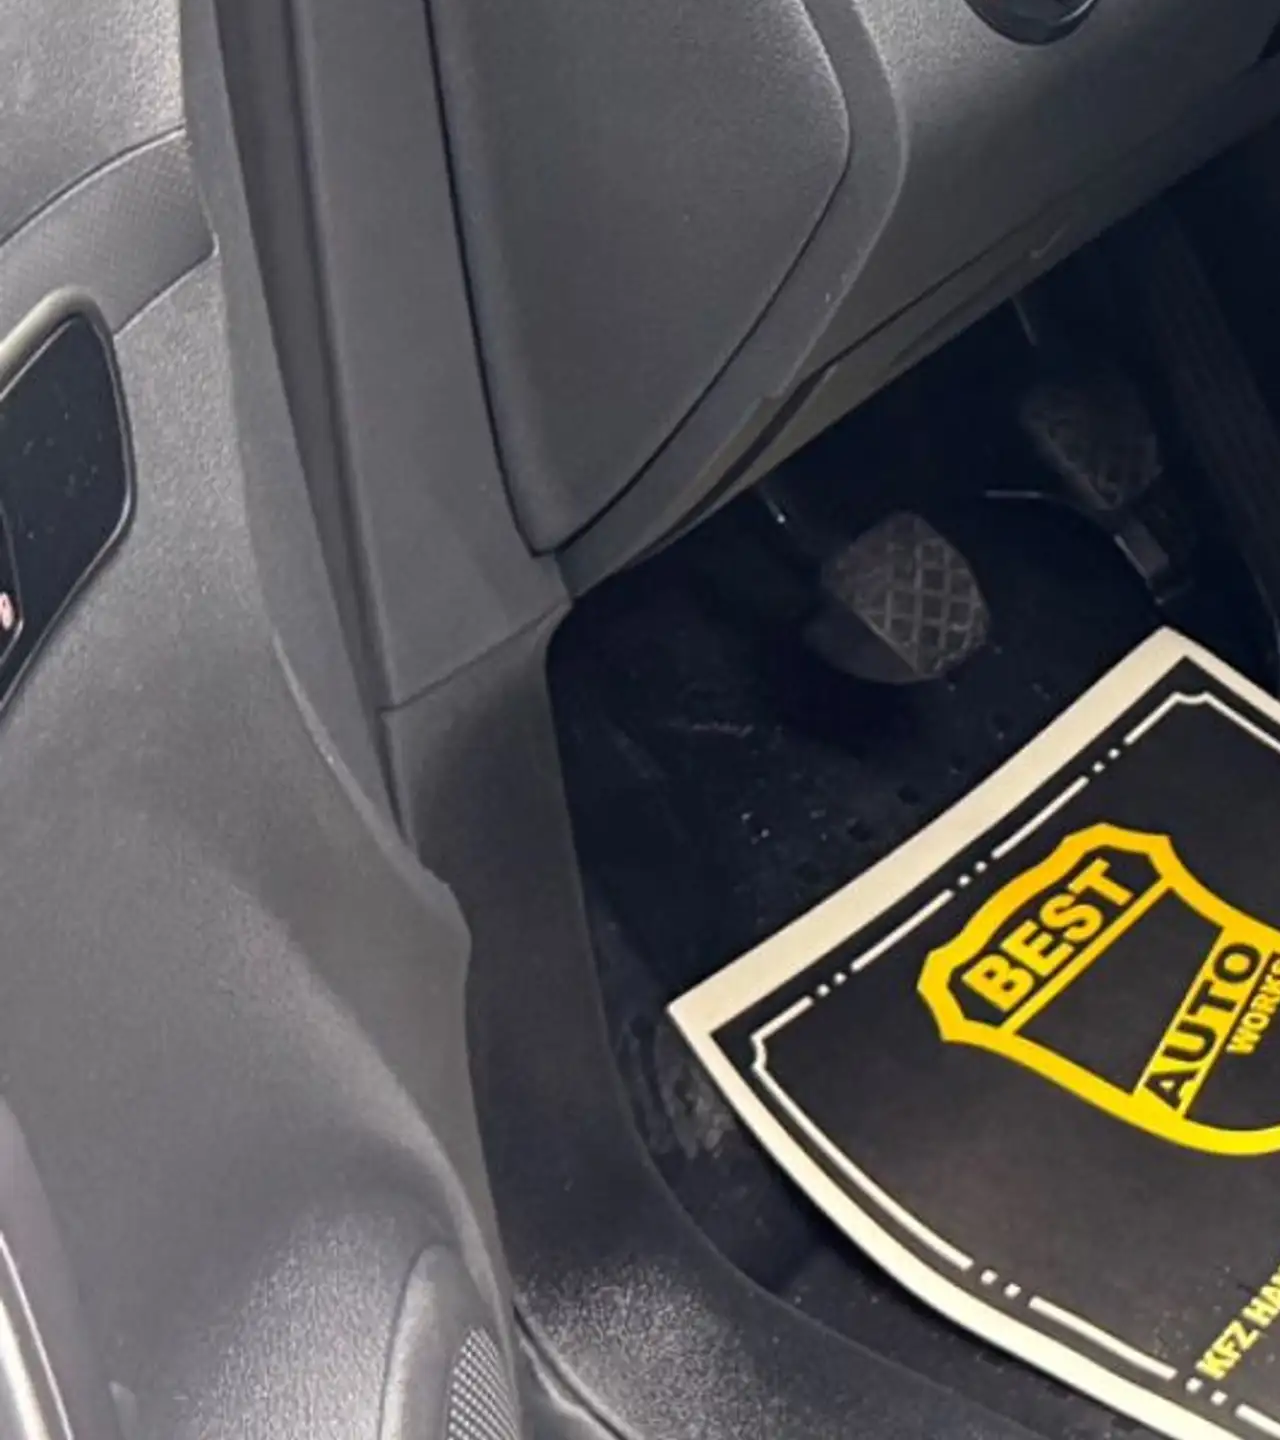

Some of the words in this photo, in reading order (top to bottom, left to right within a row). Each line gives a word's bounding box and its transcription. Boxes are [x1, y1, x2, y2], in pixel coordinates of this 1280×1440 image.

[961, 858, 1133, 1012] BEST
[1144, 942, 1263, 1110] AUTO
[1195, 1321, 1260, 1380] KFZ
